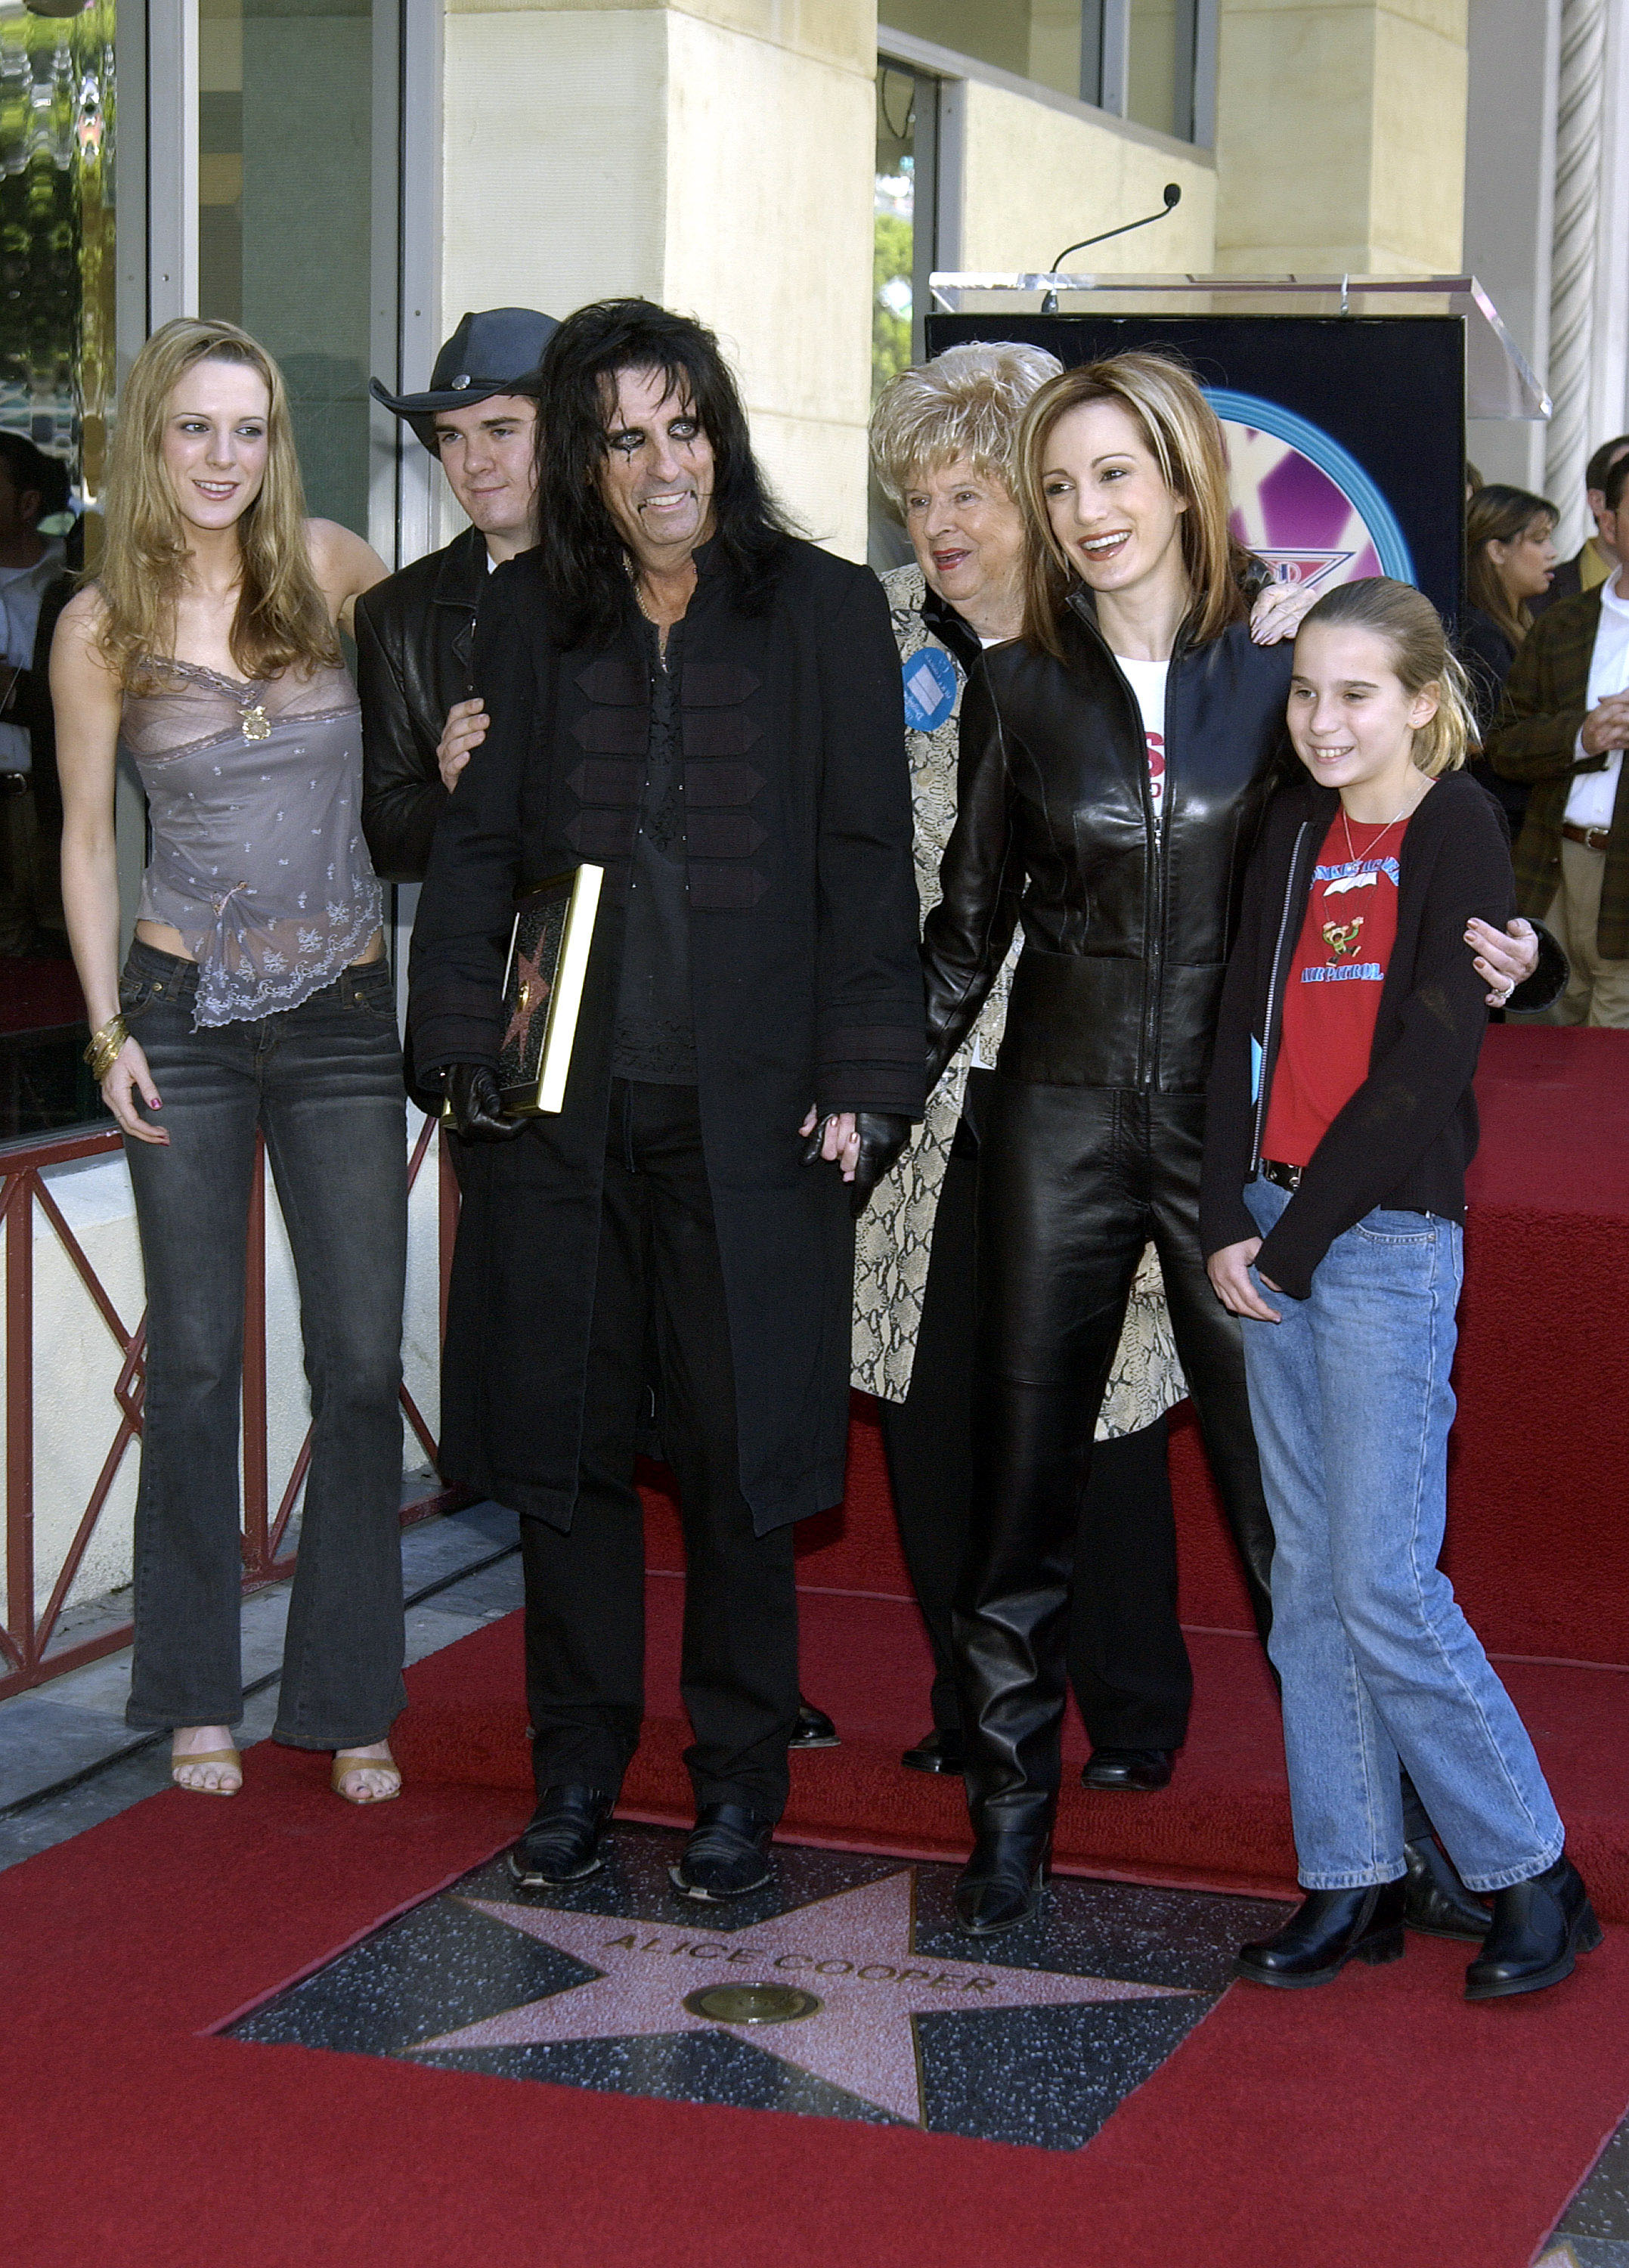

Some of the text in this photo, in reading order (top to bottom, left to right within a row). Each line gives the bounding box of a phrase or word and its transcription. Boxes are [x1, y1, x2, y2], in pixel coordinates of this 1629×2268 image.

[1325, 962, 1384, 982] PATROL
[602, 1935, 996, 1994] ALICE COOPER
